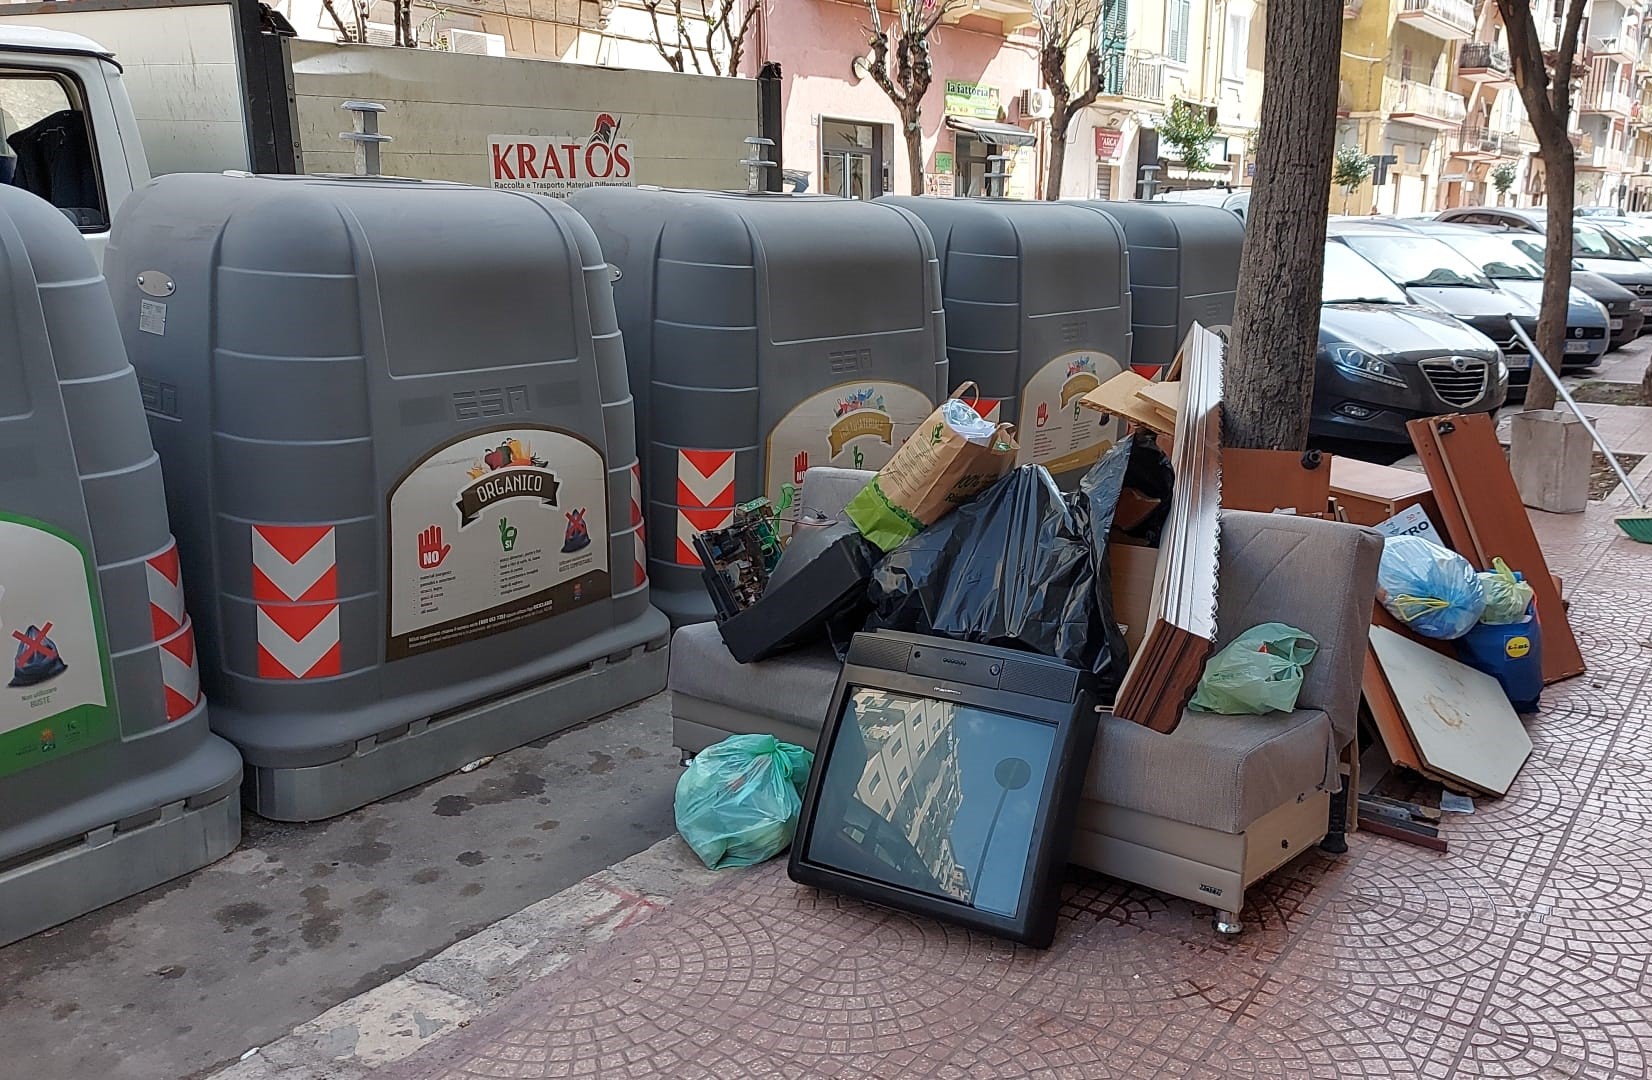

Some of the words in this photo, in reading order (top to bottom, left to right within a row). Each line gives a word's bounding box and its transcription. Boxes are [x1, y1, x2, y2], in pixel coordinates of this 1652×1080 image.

[492, 142, 631, 180] KRATOS
[494, 181, 525, 189] Raccolta
[533, 181, 565, 190] Trasporto
[476, 474, 543, 503] ORGANICO
[423, 550, 440, 566] NO
